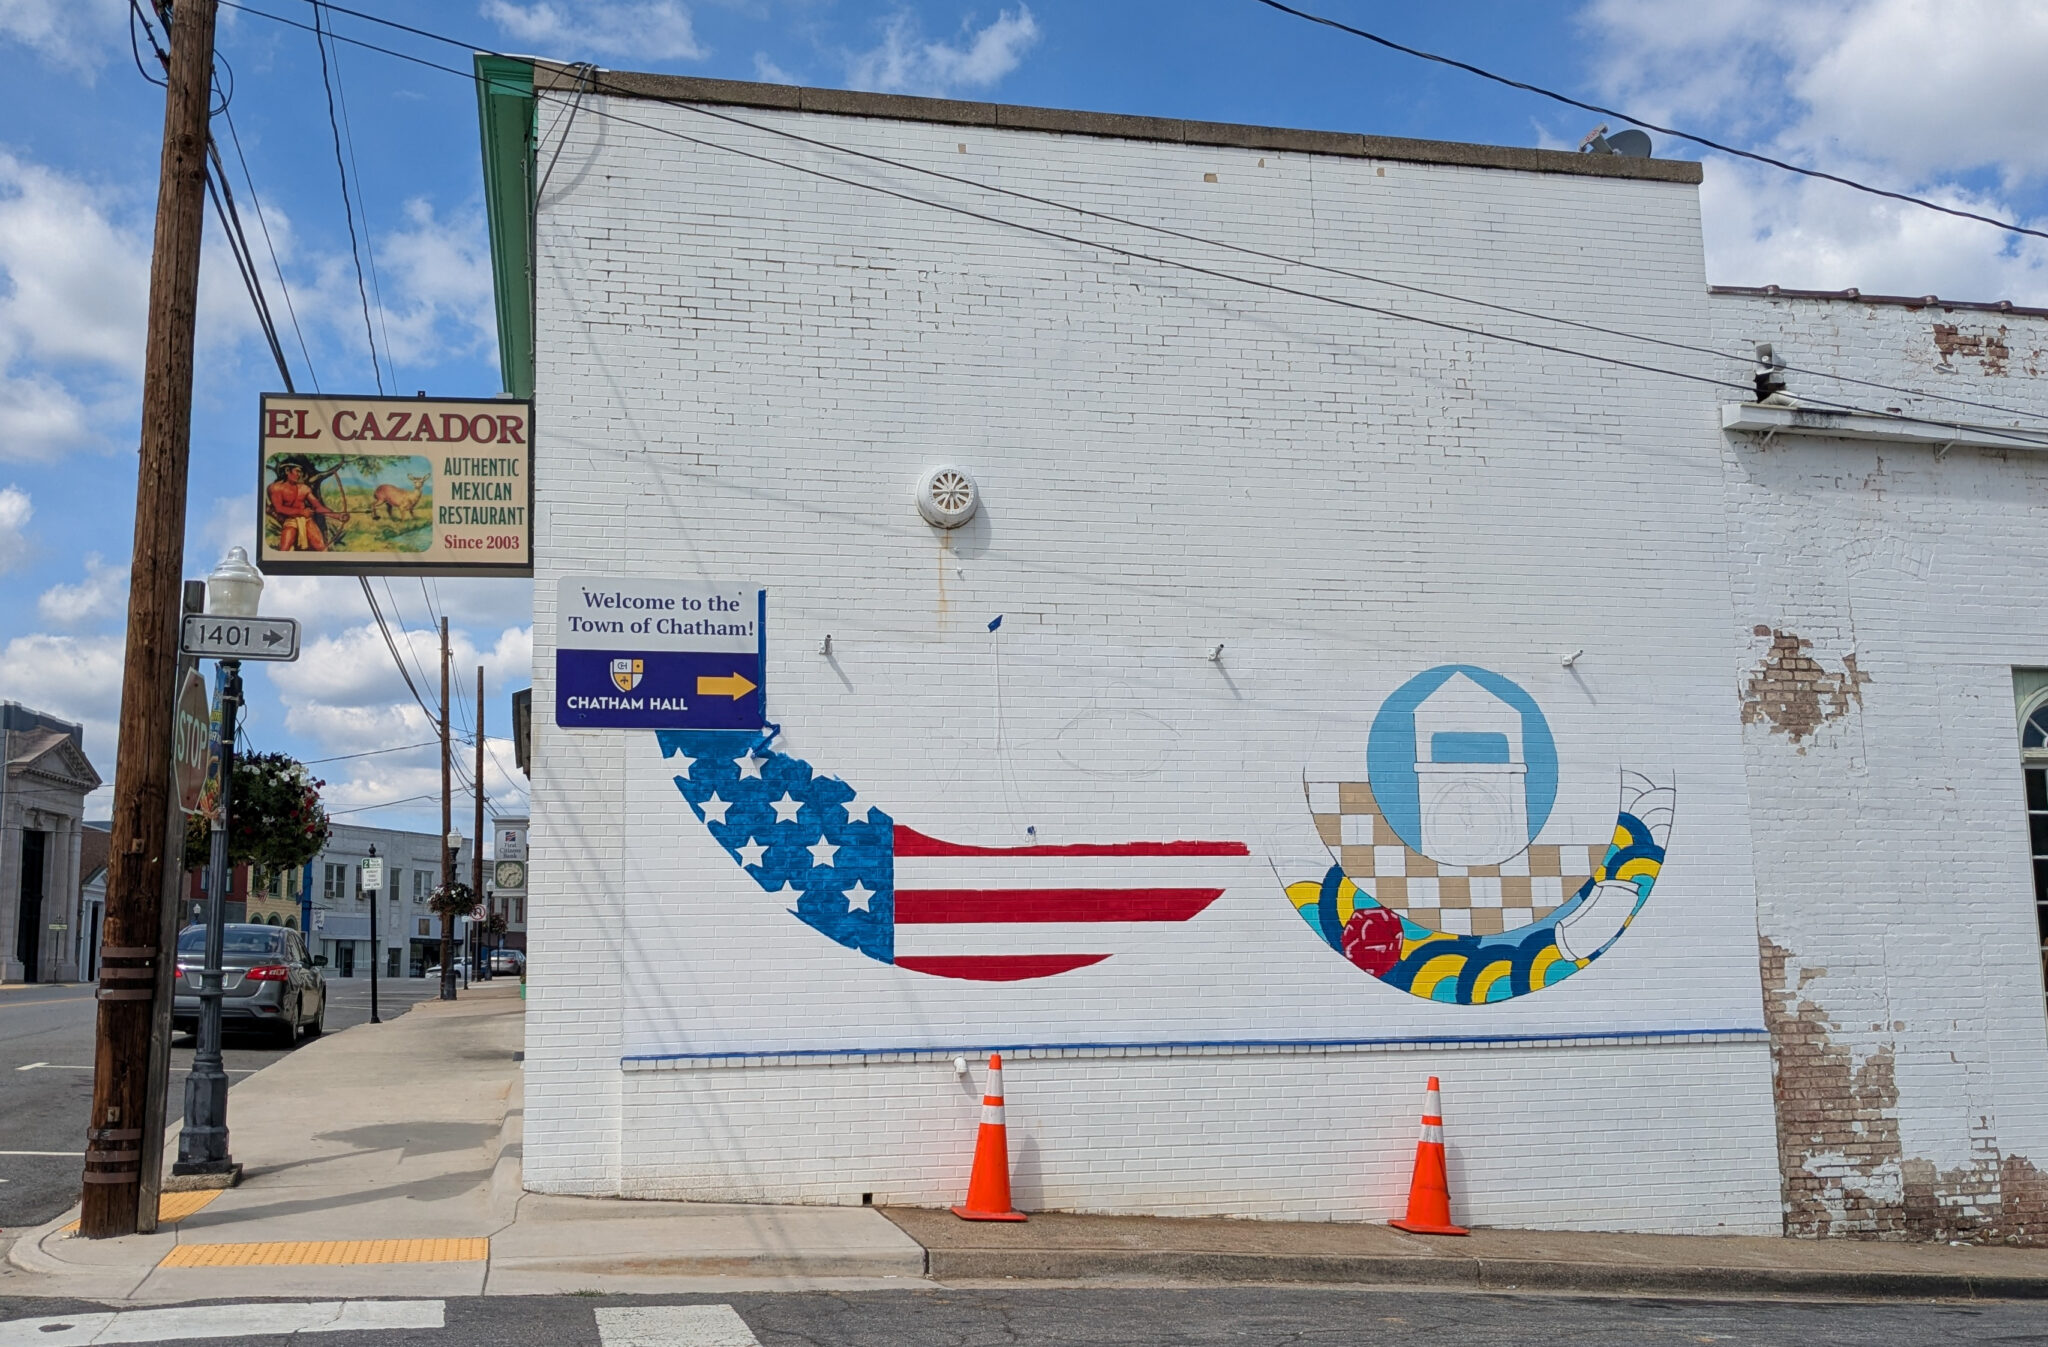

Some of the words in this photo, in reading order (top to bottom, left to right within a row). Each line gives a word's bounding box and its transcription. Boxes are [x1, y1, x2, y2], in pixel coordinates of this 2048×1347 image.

[265, 409, 321, 439] EL
[331, 410, 526, 444] CAZADOR
[444, 457, 520, 477] AUTHENTIC
[451, 482, 512, 501] MEXICAN
[439, 506, 525, 525] RESTAURANT
[444, 534, 483, 549] Since
[486, 535, 520, 550] 2003
[583, 592, 675, 611] Welcome
[681, 596, 702, 612] to
[708, 595, 740, 612] the
[200, 624, 250, 646] 1401
[568, 616, 624, 633] Town
[630, 618, 652, 634] of
[656, 618, 754, 636] Chatham!
[567, 696, 644, 710] CHATHAM
[650, 698, 688, 711] HALL
[177, 710, 207, 770] STOP
